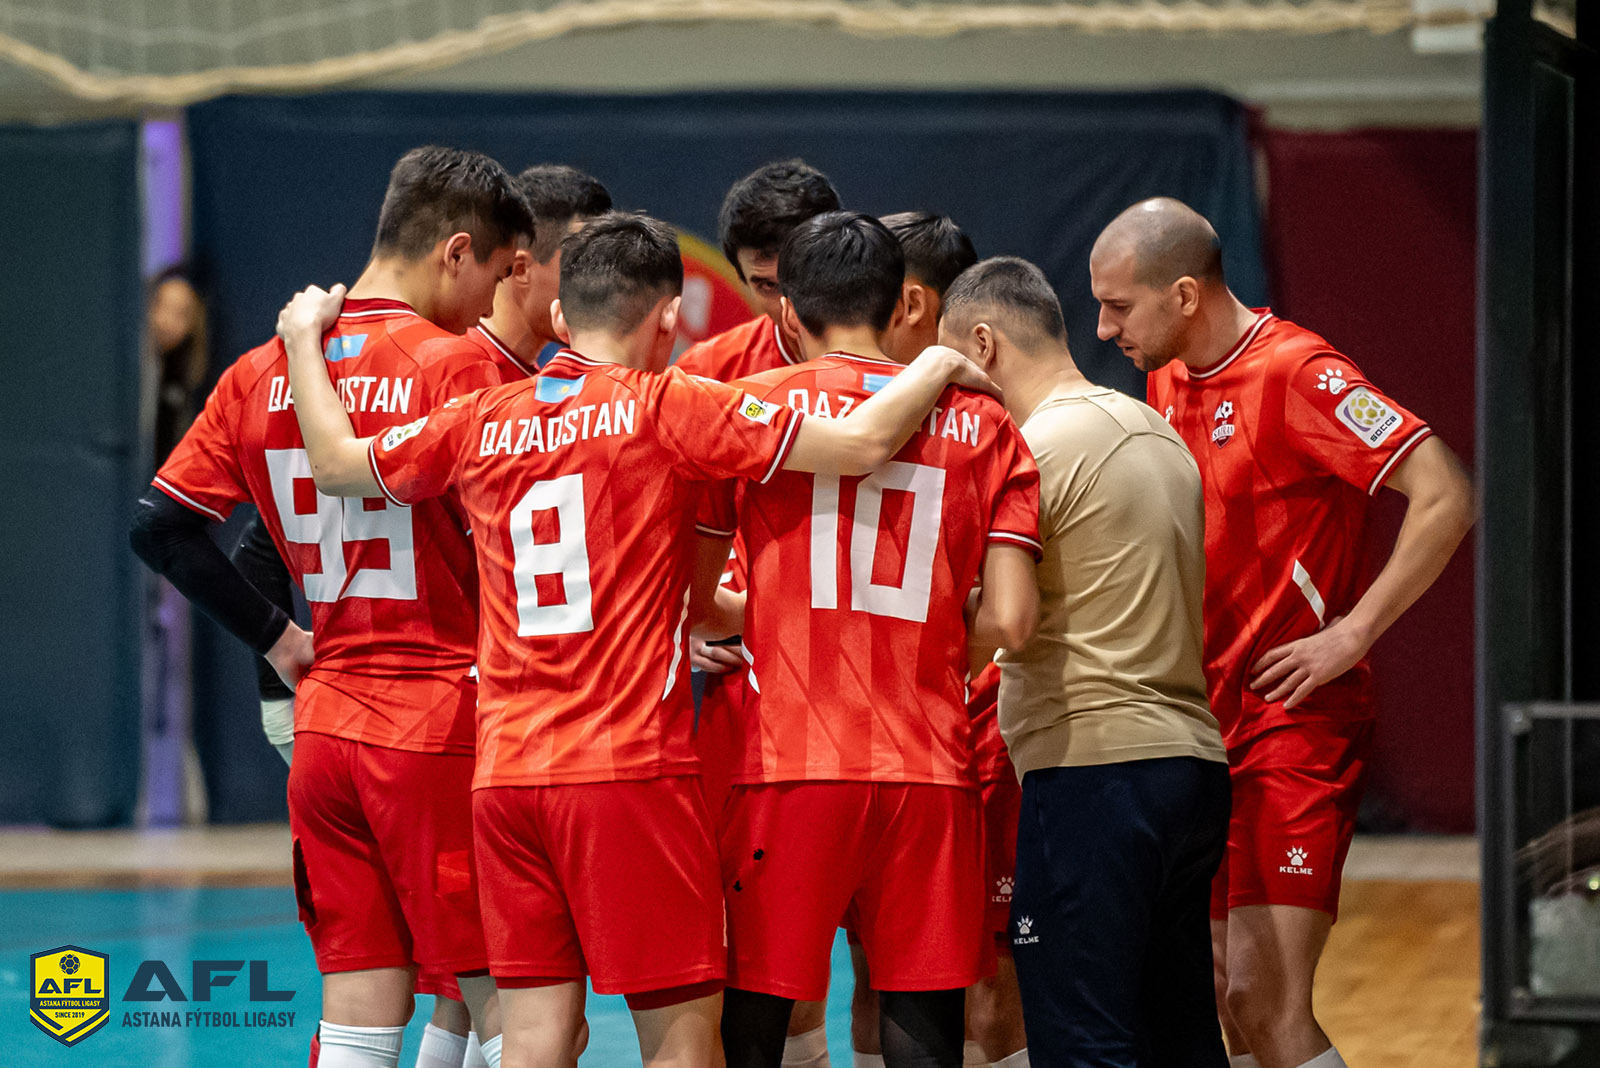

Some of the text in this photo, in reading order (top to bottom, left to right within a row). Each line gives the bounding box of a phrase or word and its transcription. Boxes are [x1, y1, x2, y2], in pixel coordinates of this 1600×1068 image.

[479, 399, 636, 457] QAZAQSTAN
[788, 388, 980, 447] QAZTAN
[265, 449, 417, 603] 99
[510, 473, 594, 637] 8
[811, 461, 946, 623] 10
[1279, 866, 1313, 875] KELME
[1014, 935, 1039, 945] KELME
